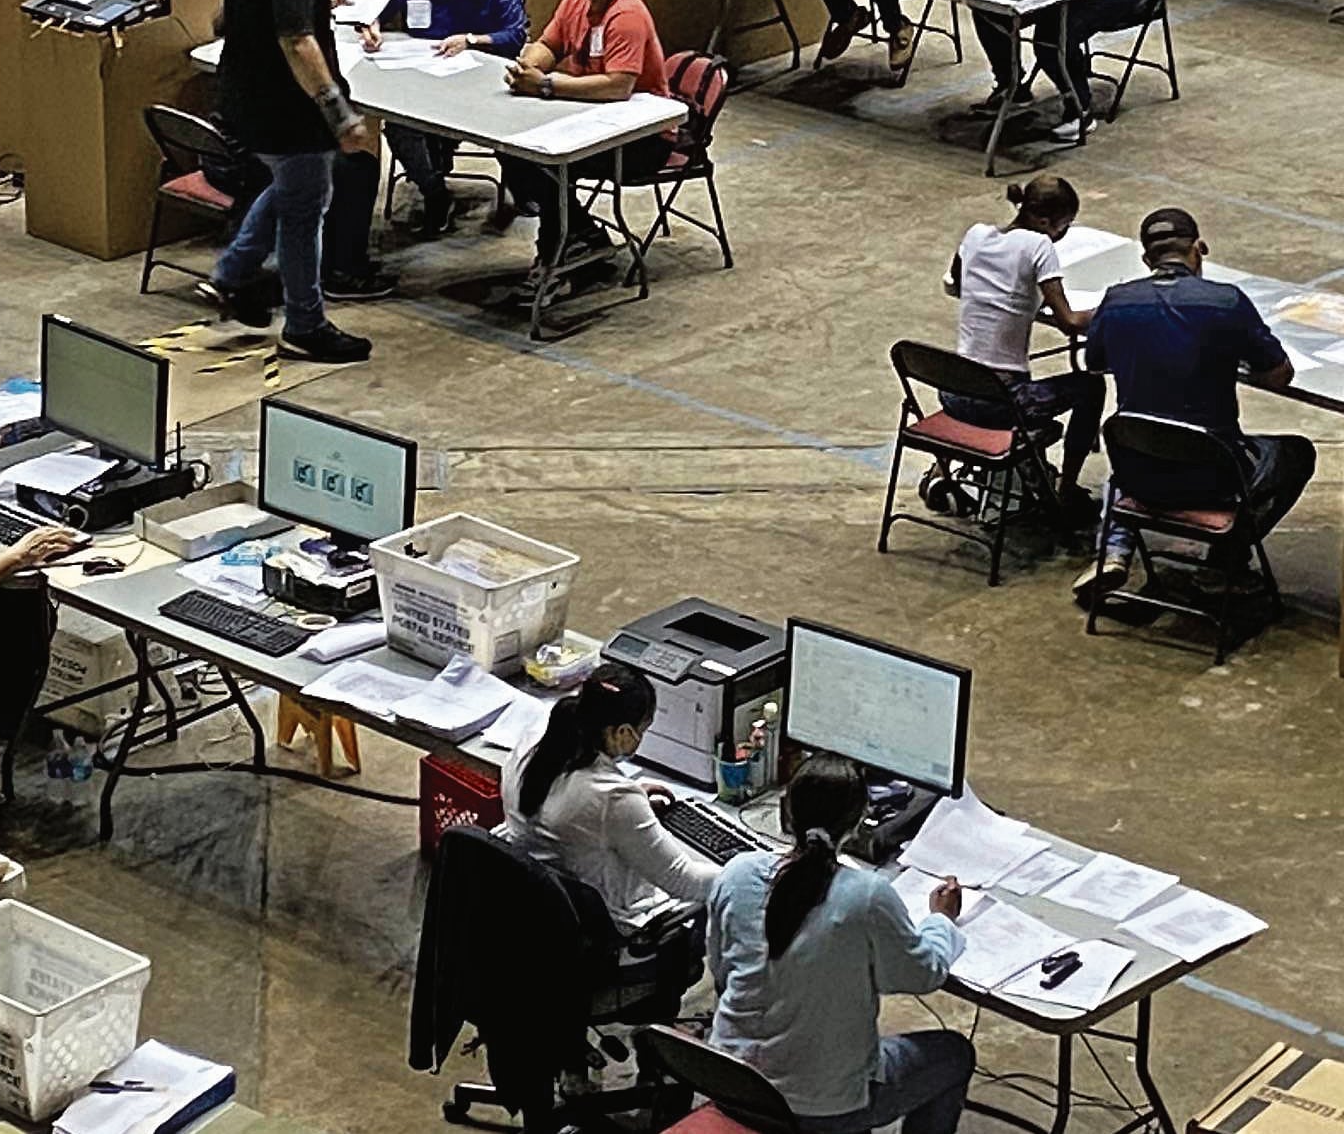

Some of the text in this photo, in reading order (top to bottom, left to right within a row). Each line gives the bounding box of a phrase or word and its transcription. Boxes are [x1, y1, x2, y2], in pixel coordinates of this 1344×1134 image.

[392, 613, 474, 653] POSTAL SERVICE
[394, 602, 471, 639] UNITED STATES
